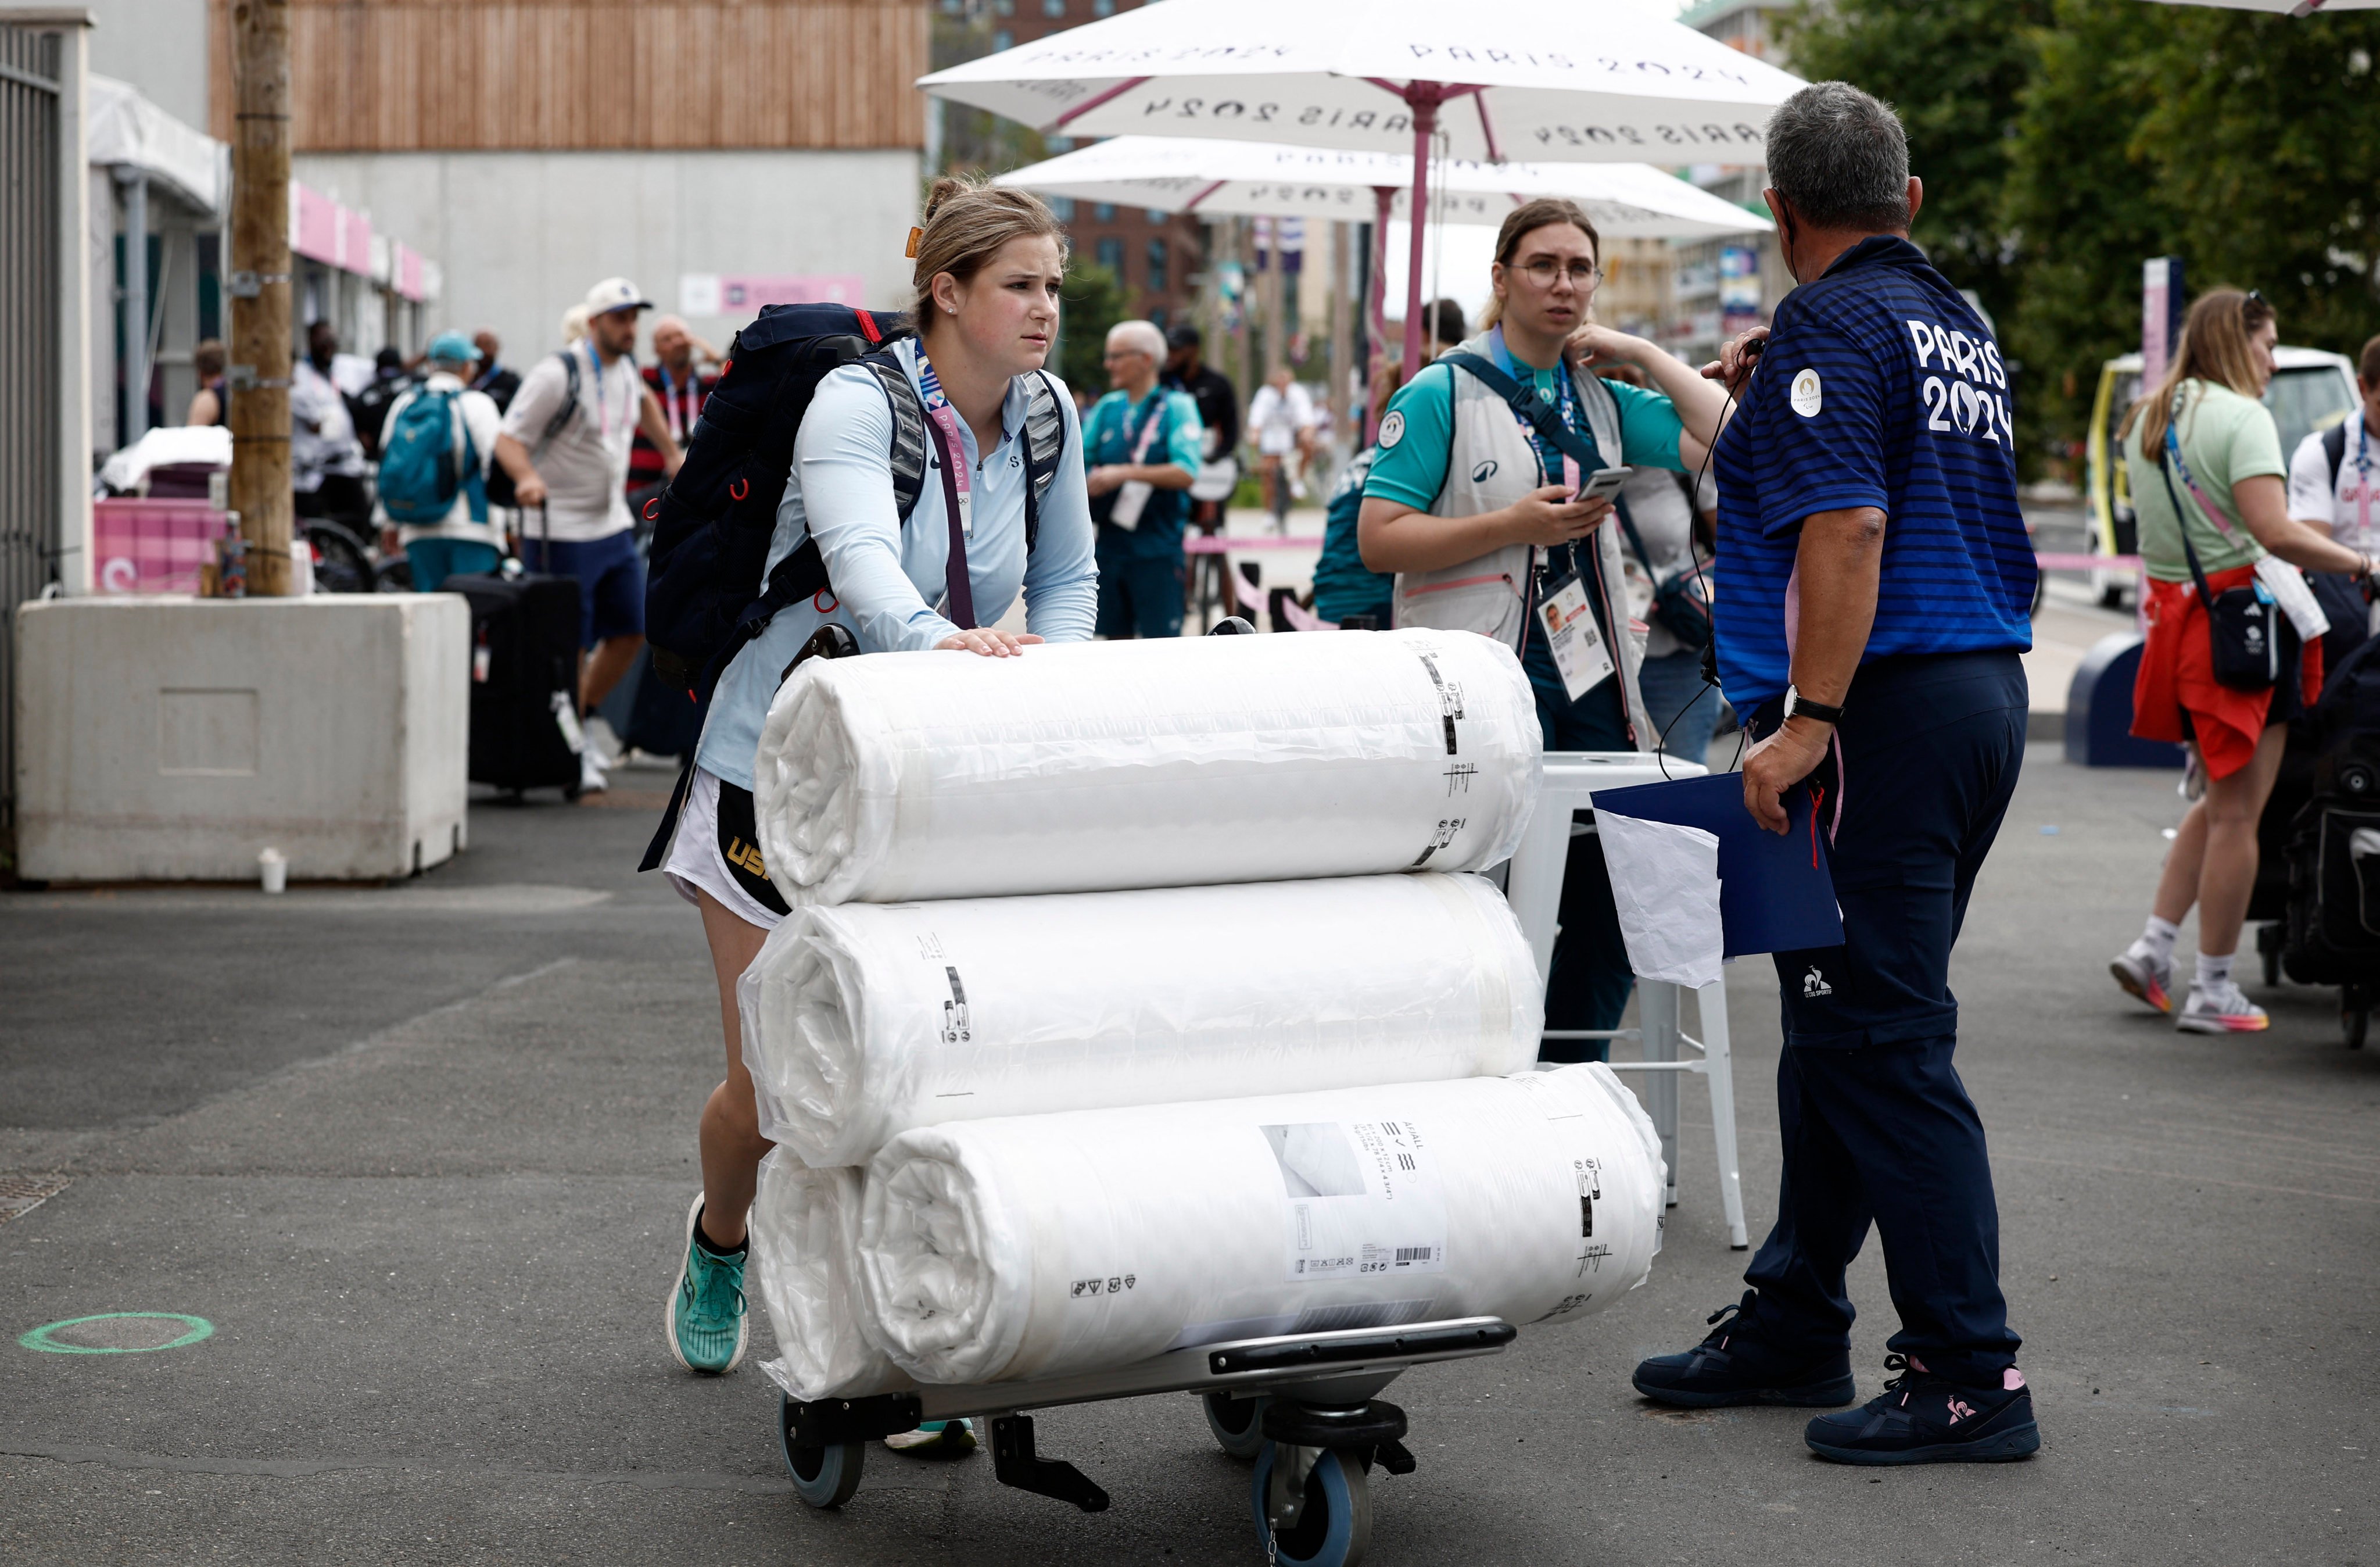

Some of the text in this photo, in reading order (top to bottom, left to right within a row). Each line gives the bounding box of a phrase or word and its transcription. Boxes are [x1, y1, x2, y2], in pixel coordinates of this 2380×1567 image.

[1410, 45, 1749, 85] PARIS 2024
[1923, 375, 2013, 452] 2024
[952, 452, 965, 487] 2024
[727, 836, 770, 881] US
[1372, 1147, 1380, 1155] 78
[1376, 1157, 1384, 1168] 3/4
[1374, 1136, 1383, 1147] 200
